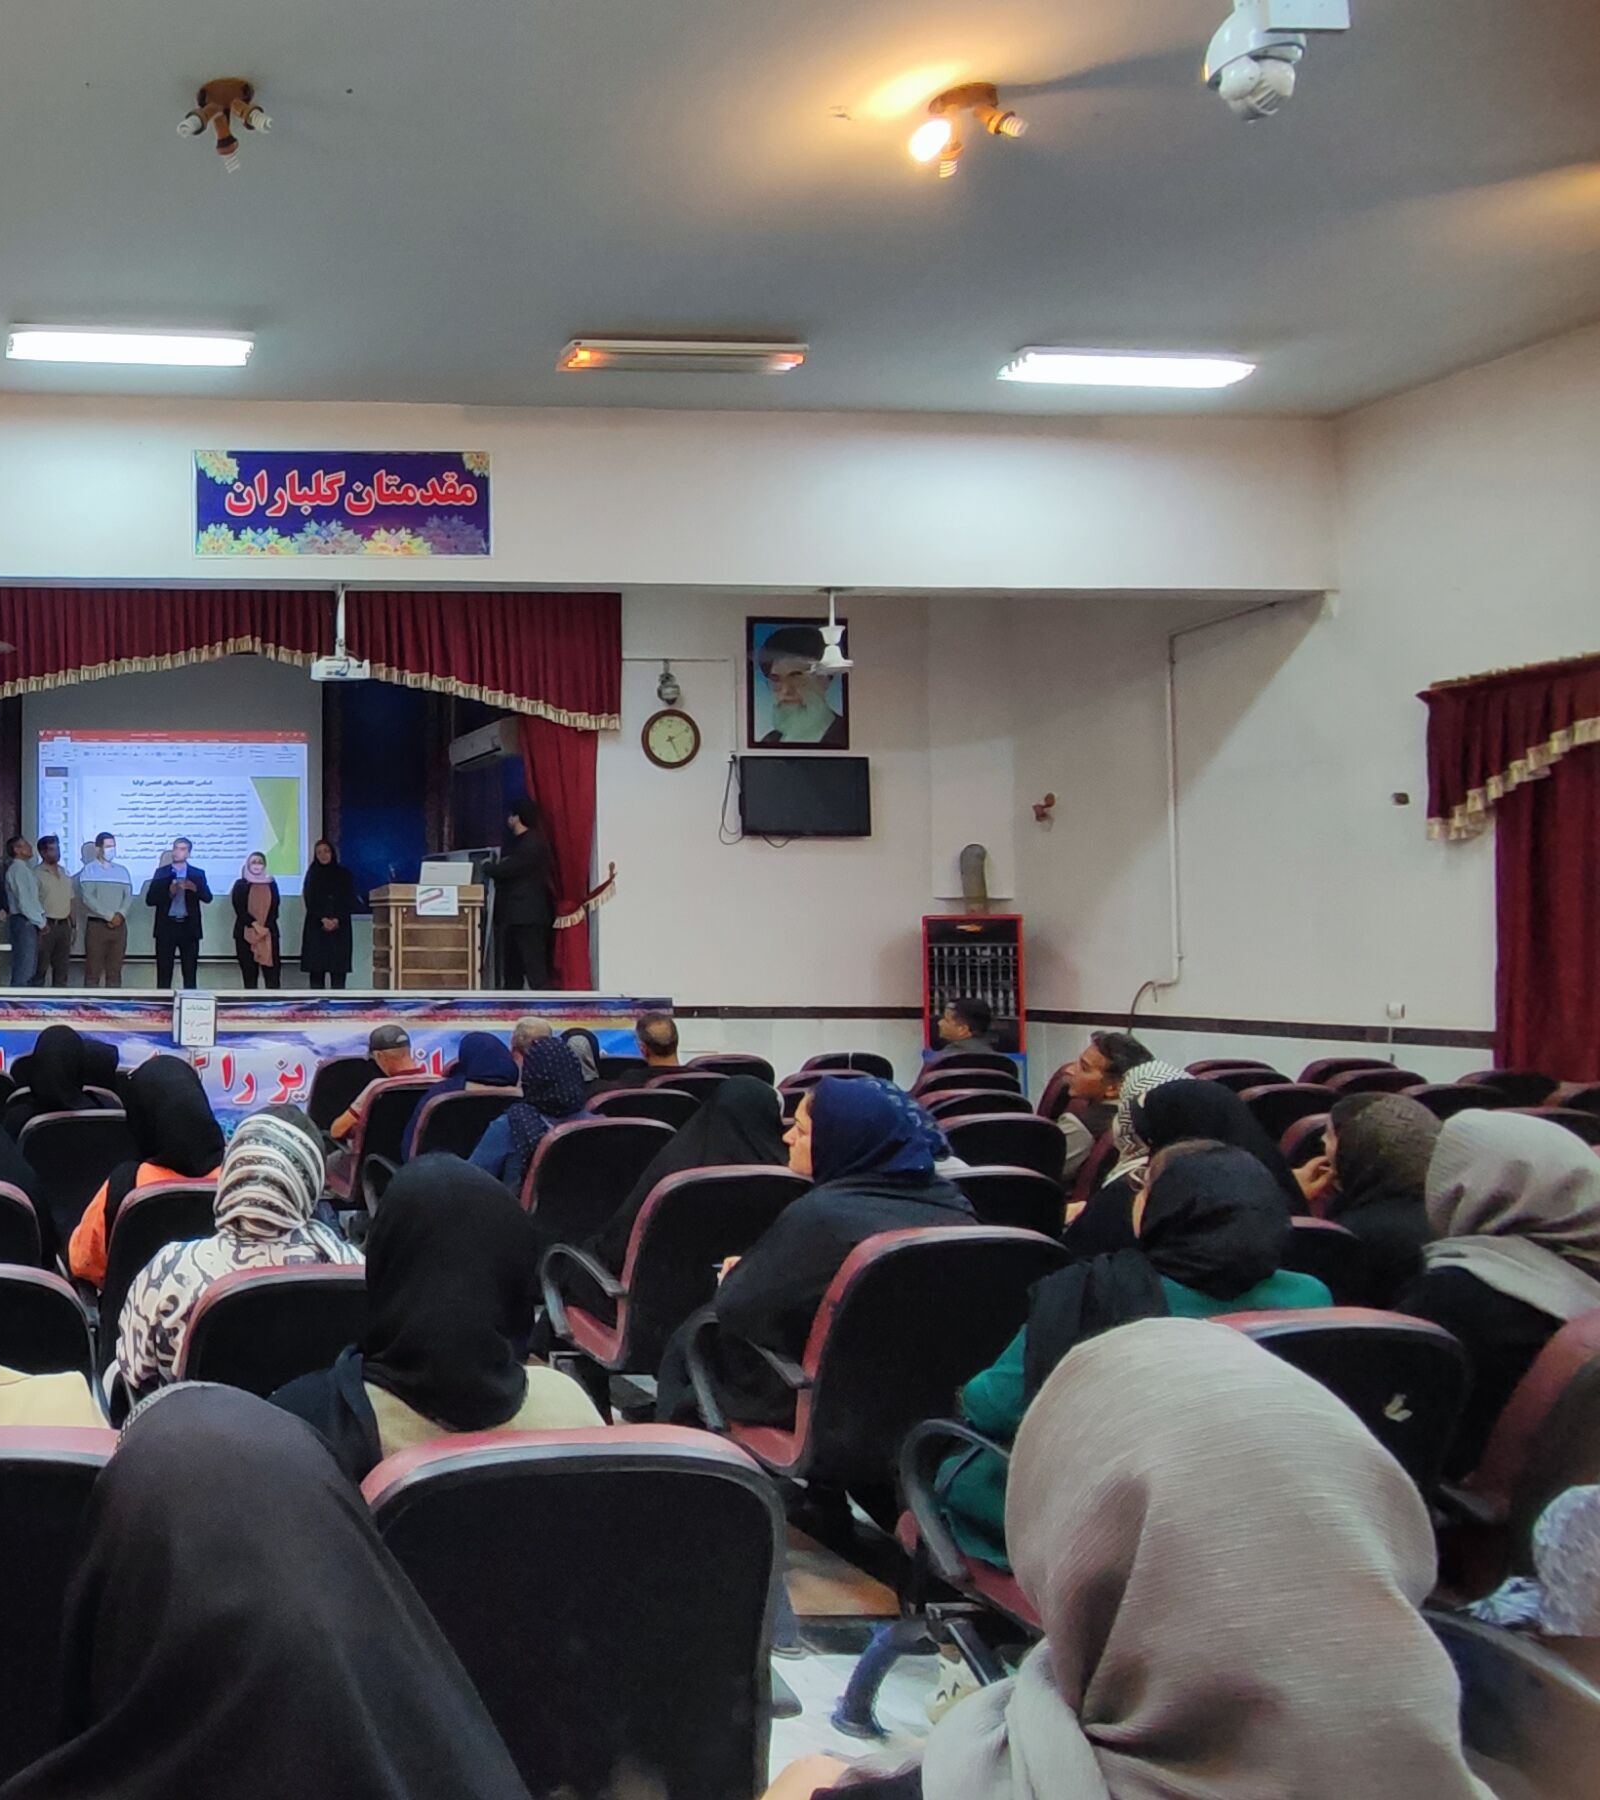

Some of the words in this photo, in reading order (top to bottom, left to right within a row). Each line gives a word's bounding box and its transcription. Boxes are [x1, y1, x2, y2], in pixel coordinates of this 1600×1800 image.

[225, 469, 346, 516] گلباران
[345, 469, 477, 516] مقدمتان
[221, 1051, 257, 1105] را
